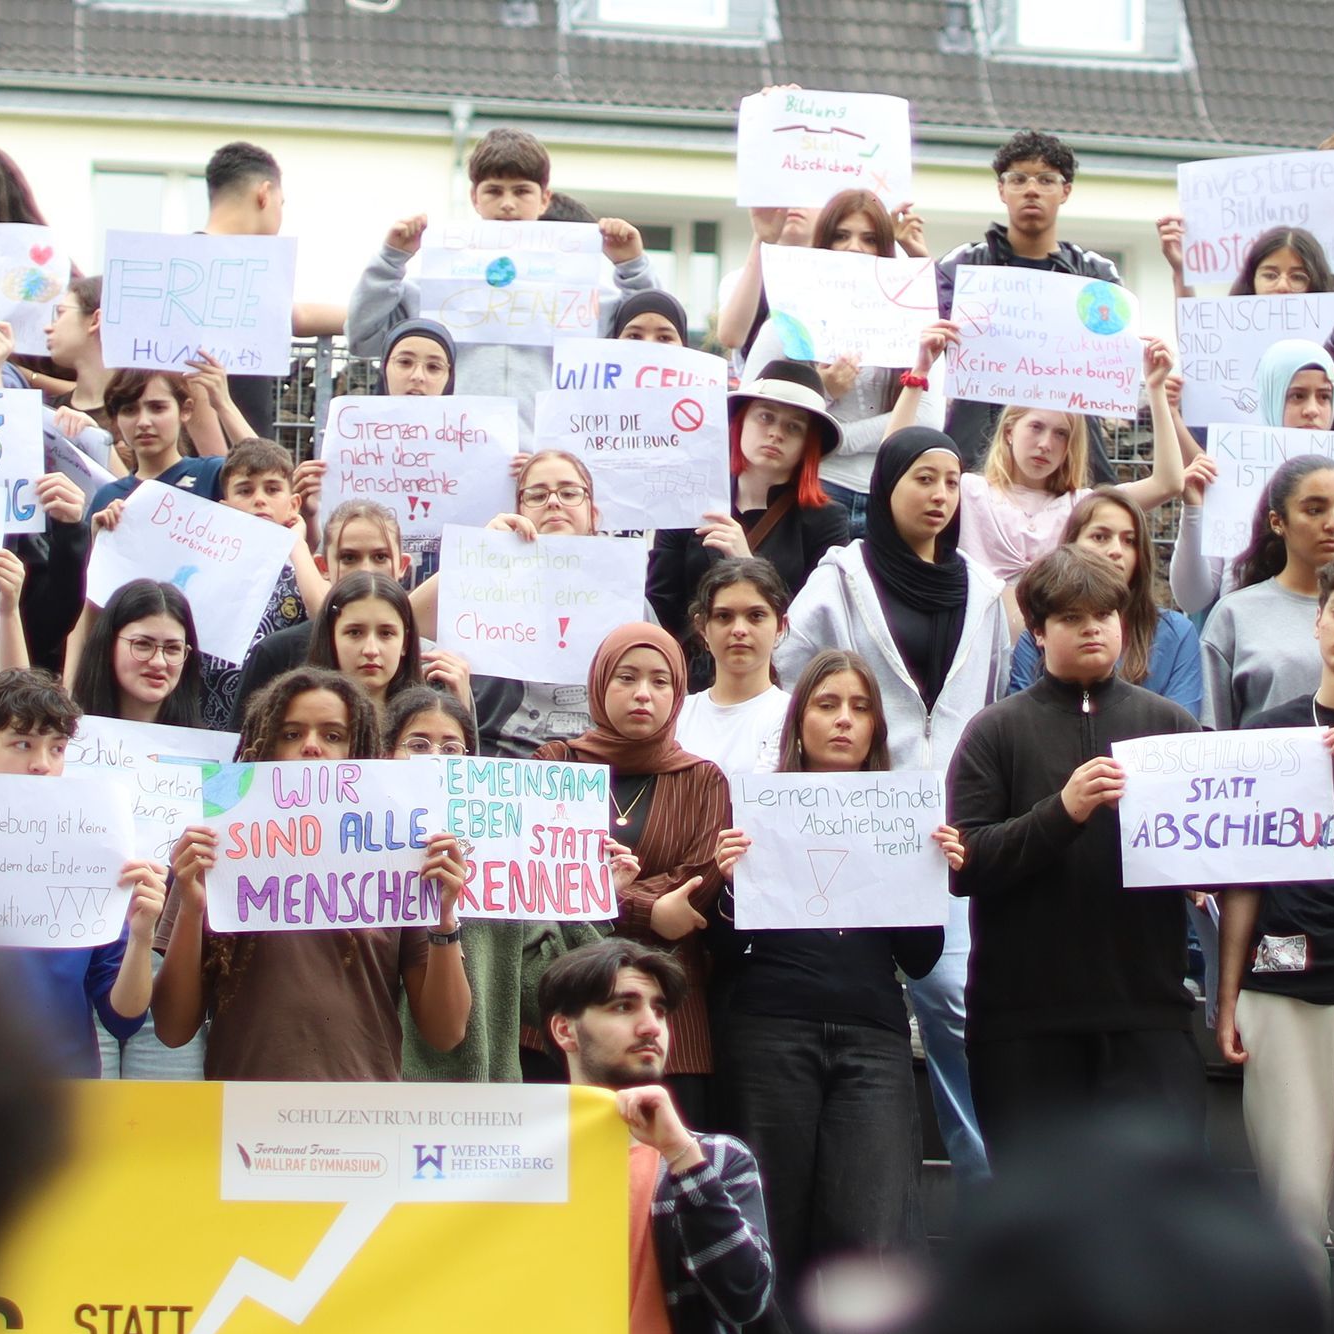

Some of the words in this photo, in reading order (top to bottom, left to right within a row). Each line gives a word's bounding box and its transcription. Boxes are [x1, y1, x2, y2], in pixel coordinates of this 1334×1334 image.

[785, 95, 847, 118] Bildung
[1221, 196, 1310, 230] Bildung
[105, 258, 269, 329] FREE
[987, 298, 1043, 321] durch
[1181, 296, 1321, 331] MENSCHEN
[990, 324, 1048, 346] Bildung
[1178, 333, 1223, 355] SIND
[1181, 359, 1241, 381] KEINE
[1067, 391, 1137, 413] Menschen
[337, 405, 427, 440] Grenzen
[569, 413, 609, 433] STOPT
[619, 413, 642, 431] DIE
[340, 442, 385, 466] nicht
[583, 434, 680, 451] ABSCHIEBUNG
[1215, 428, 1288, 463] KEIN
[150, 491, 243, 562] Bildung
[455, 611, 537, 643] Chanse
[272, 762, 362, 809] WIR
[444, 757, 606, 802] EMEINSAM
[1186, 777, 1257, 803] STATT
[741, 778, 831, 807] Lernen
[835, 778, 942, 809] verbindet
[445, 798, 523, 839] EBEN
[799, 811, 916, 841] Abschiebung
[225, 814, 322, 860] SIND
[339, 808, 430, 855] ALLE
[529, 824, 608, 862] STATT
[873, 834, 924, 857] trennt
[26, 854, 48, 873] das
[51, 850, 82, 875] Ende
[86, 863, 108, 874] von
[236, 868, 441, 924] MENSCHEN
[457, 860, 612, 914] RENNEN
[277, 1109, 423, 1126] SCHULZENTRUM
[428, 1111, 524, 1127] BUCHHEIM
[254, 1142, 307, 1156] Ferdinand
[309, 1143, 341, 1156] Franz
[451, 1144, 522, 1157] WERNER
[254, 1158, 307, 1172] WALLRAF
[309, 1158, 381, 1173] GYMNASIUM
[451, 1157, 555, 1171] HEISENBERG
